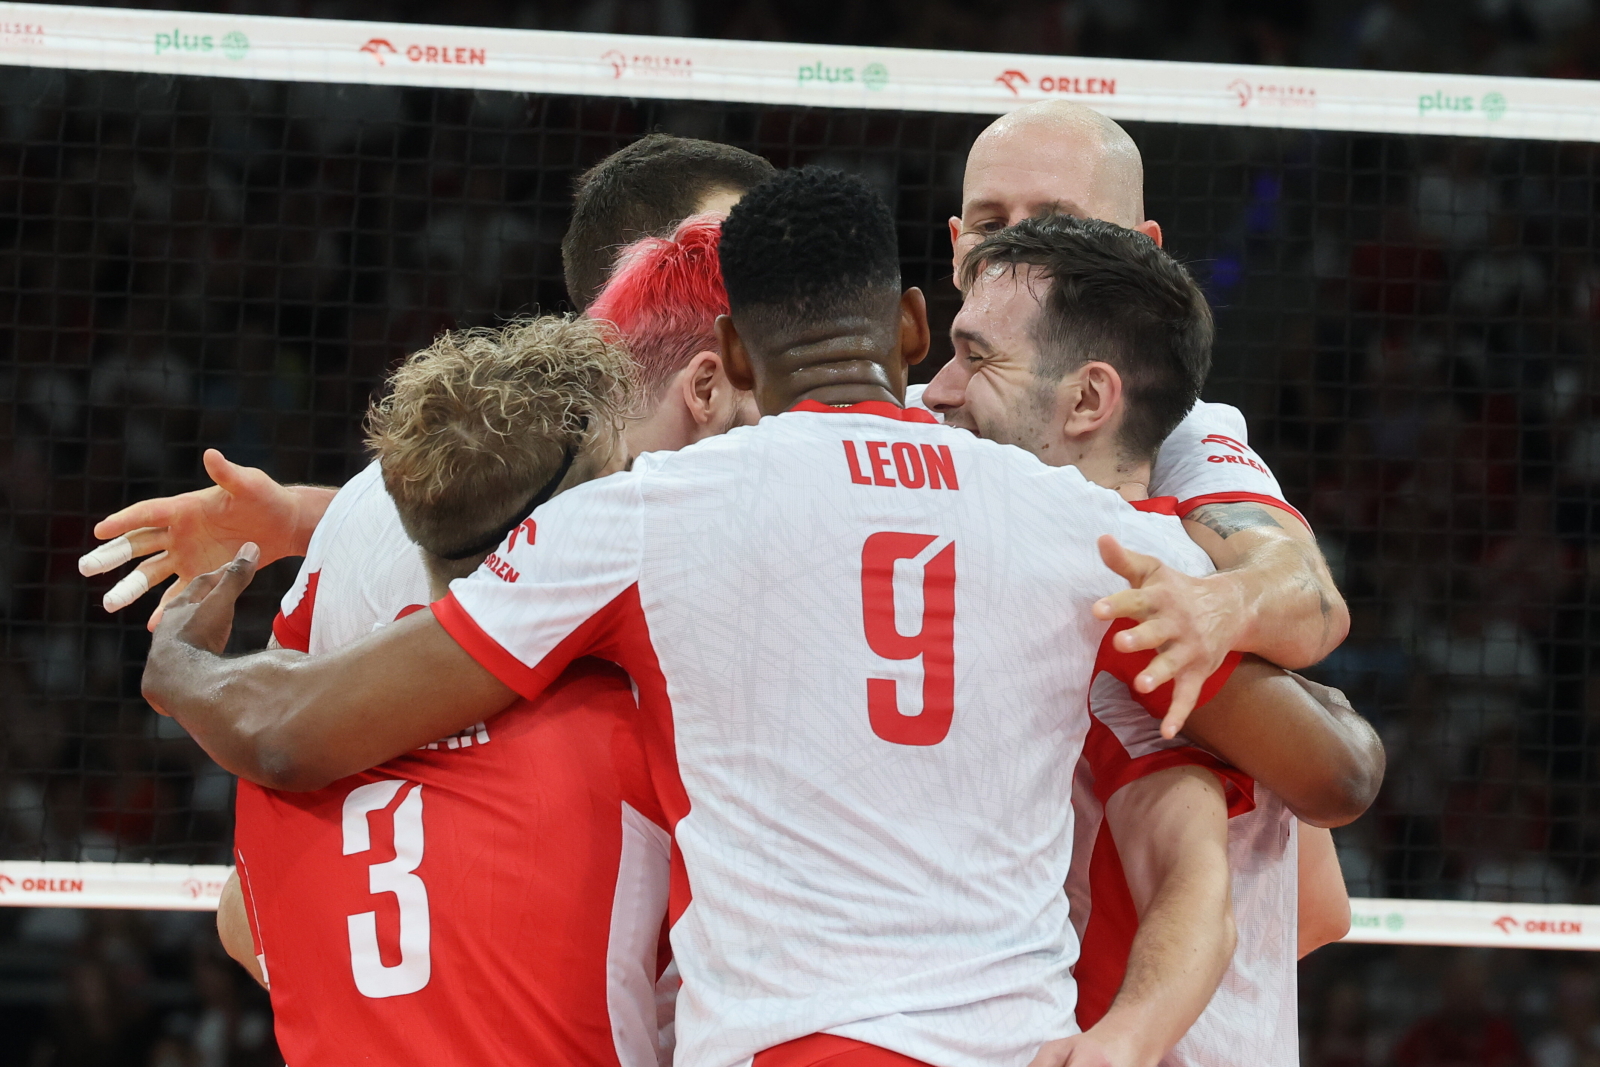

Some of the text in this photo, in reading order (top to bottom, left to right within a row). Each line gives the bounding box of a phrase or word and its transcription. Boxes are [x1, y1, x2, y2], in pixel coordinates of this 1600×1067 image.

[0, 23, 44, 35] LSKA
[155, 29, 213, 54] plus
[407, 45, 486, 66] ORLEN
[799, 62, 854, 86] plus
[1039, 76, 1116, 96] ORLEN
[1419, 91, 1474, 115] plus
[842, 440, 960, 491] LEON
[1207, 455, 1271, 479] ORLEN
[861, 531, 956, 747] 9
[22, 878, 83, 893] ORLEN
[342, 779, 431, 999] 3
[1352, 912, 1380, 928] lus
[1525, 920, 1581, 934] ORLEN
